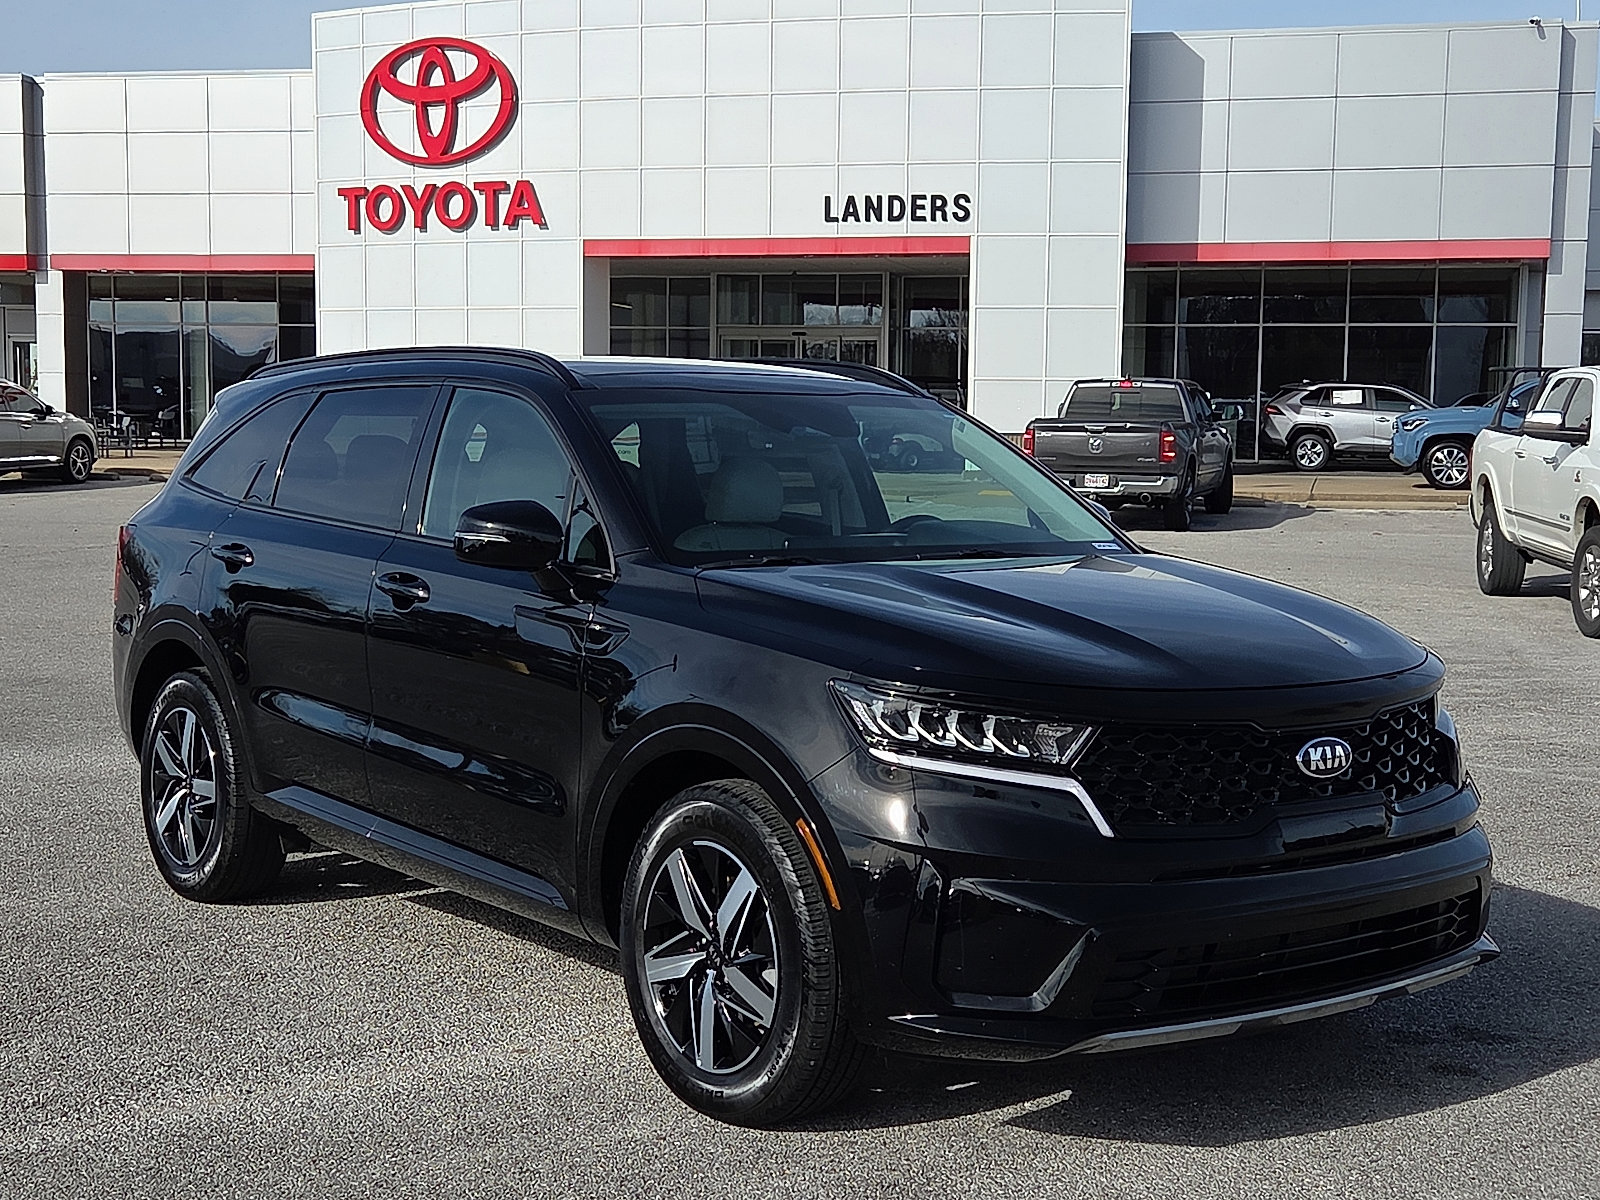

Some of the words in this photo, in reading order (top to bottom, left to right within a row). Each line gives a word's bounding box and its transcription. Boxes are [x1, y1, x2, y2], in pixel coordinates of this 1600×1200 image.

[338, 180, 547, 234] TOYOTA
[824, 193, 971, 223] LANDERS
[1308, 745, 1346, 771] KIA
